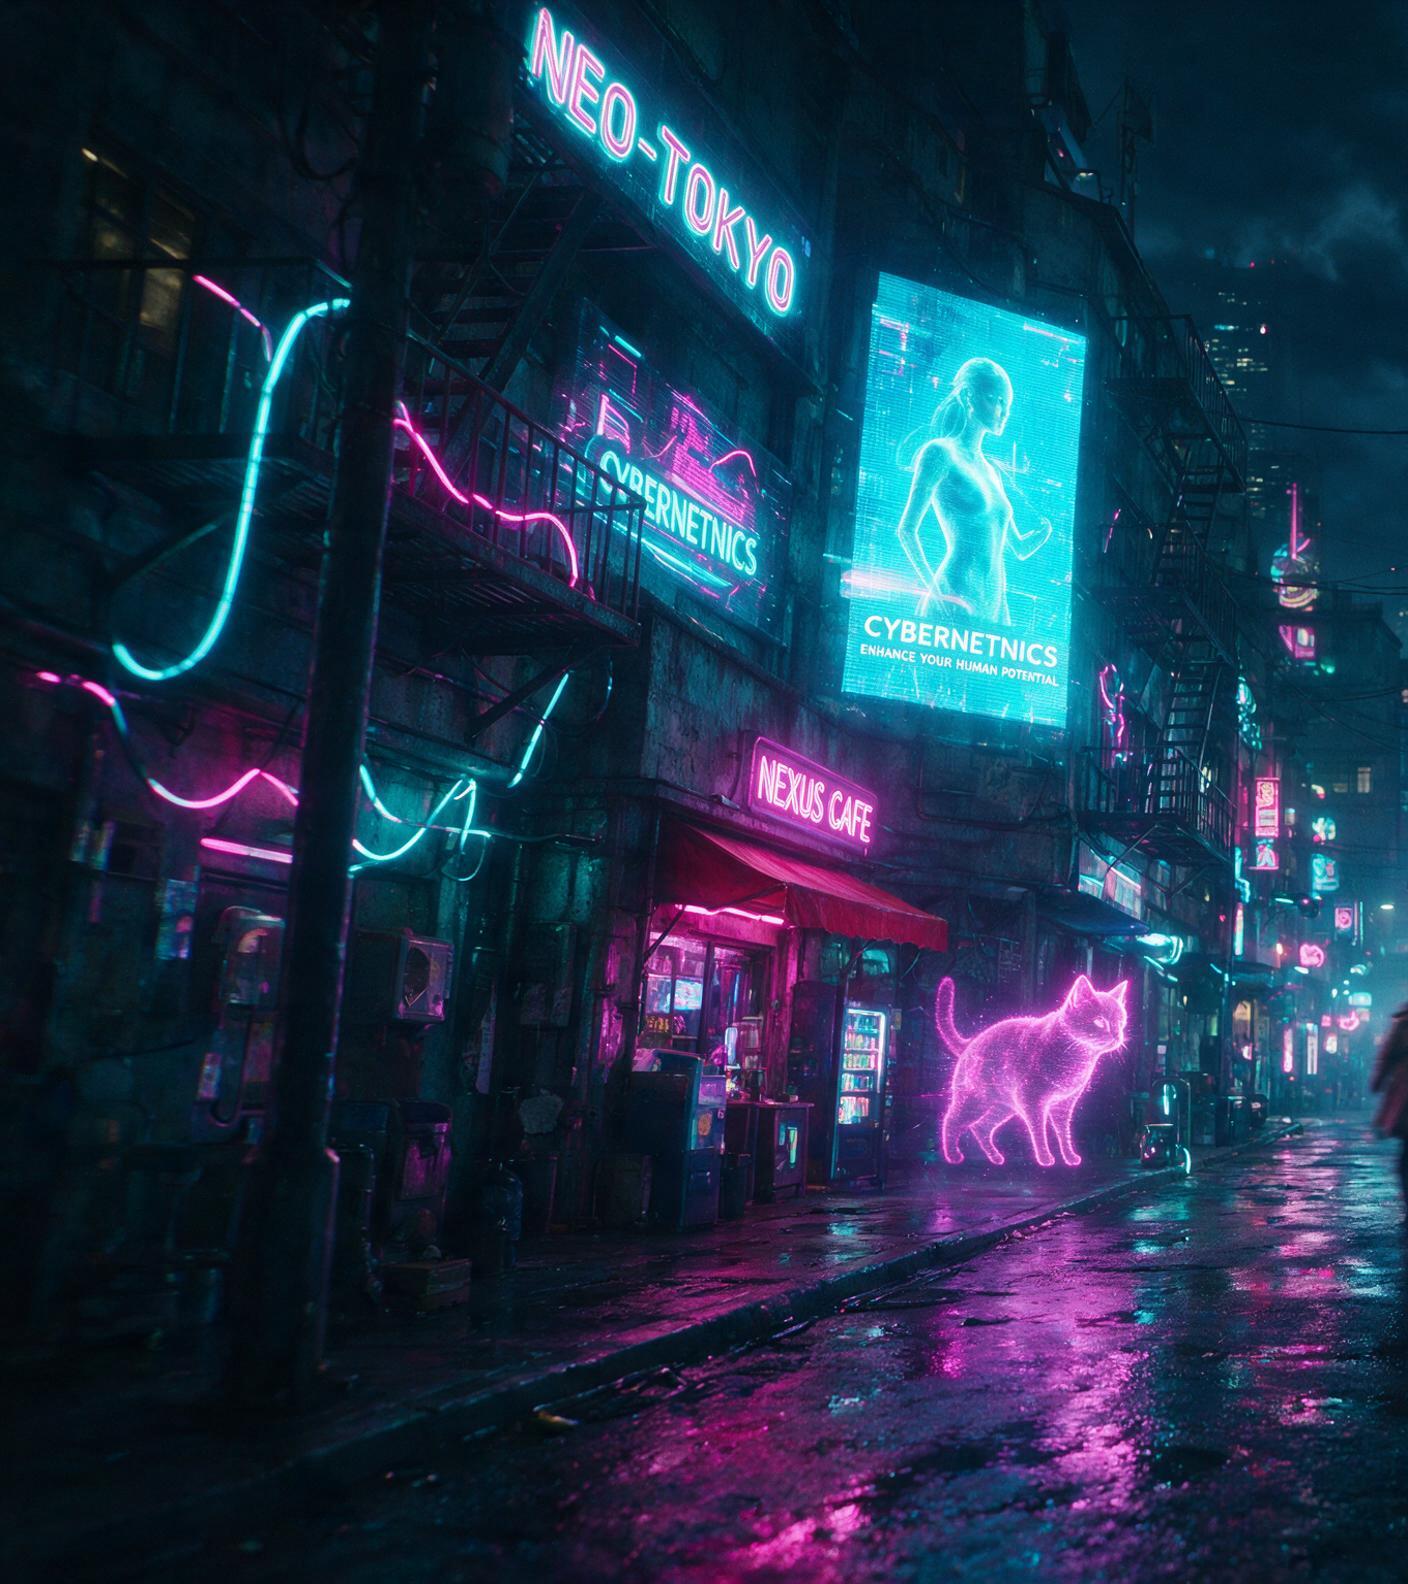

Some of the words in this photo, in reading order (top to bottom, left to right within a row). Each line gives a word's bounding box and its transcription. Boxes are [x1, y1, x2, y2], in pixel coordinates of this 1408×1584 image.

[530, 7, 796, 316] NEO-TOKYO
[860, 643, 917, 663] ENHANCE
[919, 652, 952, 668] YOUR
[956, 659, 998, 676] HUMAN
[1001, 667, 1060, 687] POTENTIAL
[864, 615, 1058, 667] CYBERNETNICS
[757, 755, 825, 823] NEXUS
[828, 790, 873, 843] CAFE
